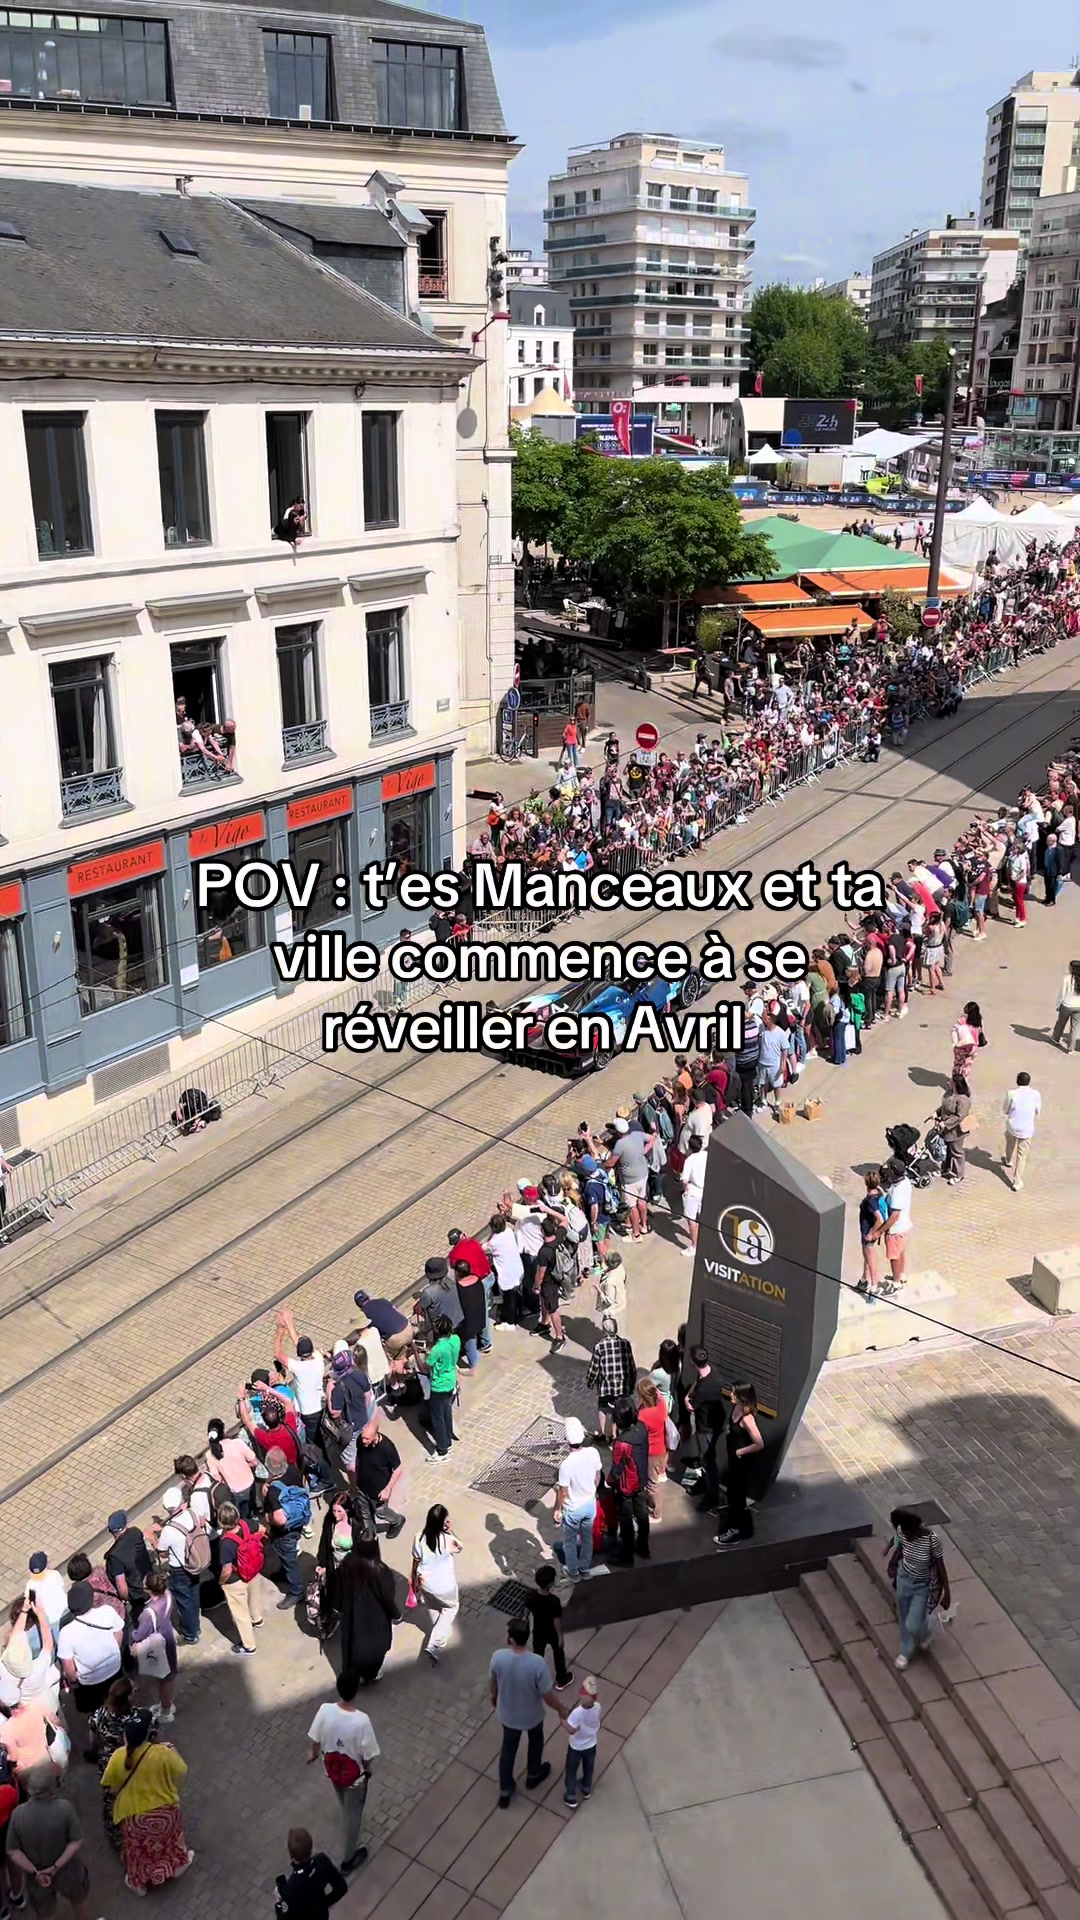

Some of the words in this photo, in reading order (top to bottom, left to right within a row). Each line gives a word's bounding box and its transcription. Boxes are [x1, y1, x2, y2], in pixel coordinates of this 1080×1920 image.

[288, 794, 347, 820] RESTAURANT
[77, 851, 153, 884] RESTAURANT
[704, 1257, 786, 1300] VISITATION
